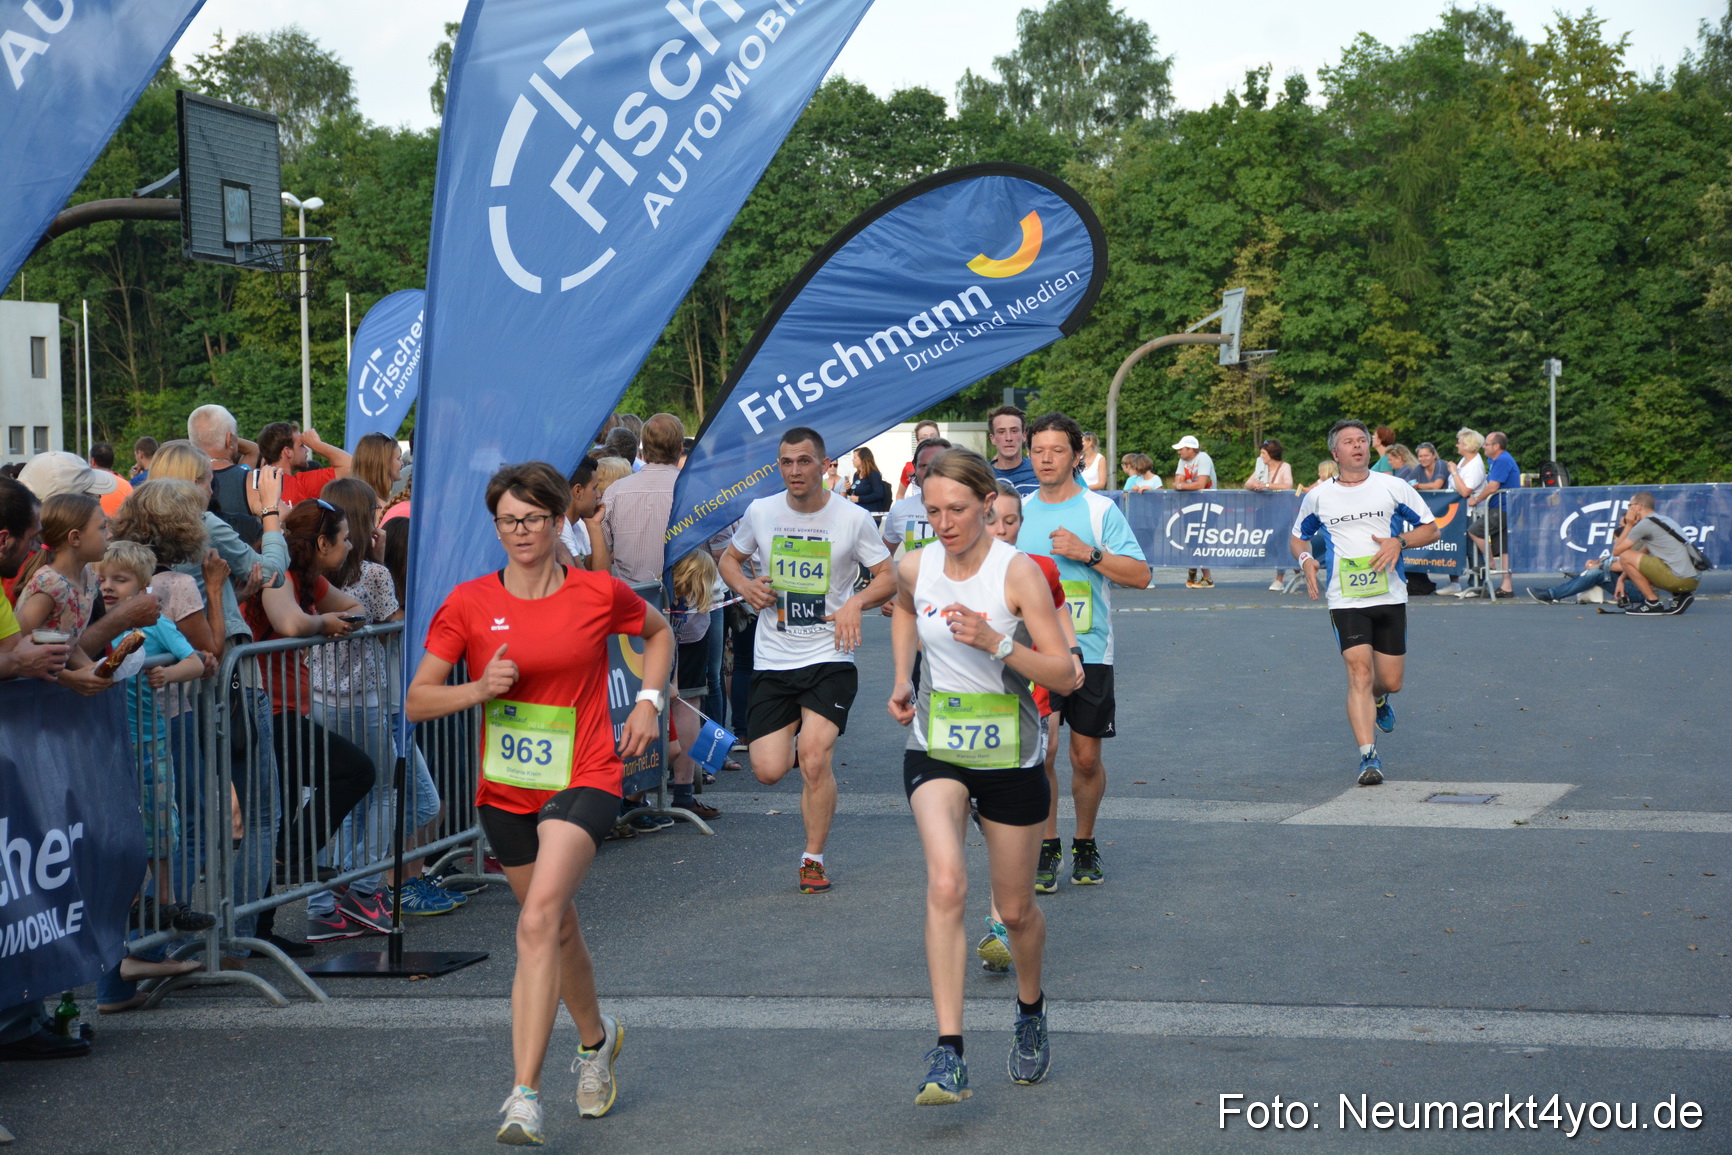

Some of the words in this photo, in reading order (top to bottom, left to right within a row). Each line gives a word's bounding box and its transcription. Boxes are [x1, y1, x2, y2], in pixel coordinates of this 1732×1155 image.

[643, 0, 803, 229] AUTOMOBI
[903, 331, 964, 372] Druck
[966, 310, 1007, 338] und
[1006, 268, 1080, 320] Medien
[393, 342, 422, 399] AUTOMO
[738, 285, 993, 434] Frischmann
[664, 458, 780, 545] www.frischmann-
[1330, 510, 1384, 525] DELPHI
[1184, 523, 1274, 545] Fischer
[1587, 522, 1715, 546] Fier
[1193, 547, 1266, 558] AUTOMOBILE
[776, 559, 824, 579] 1164
[1349, 571, 1378, 587] 292
[791, 602, 815, 618] RW
[501, 733, 553, 766] 963
[947, 724, 1001, 750] 578
[0, 900, 84, 958] MOBILE
